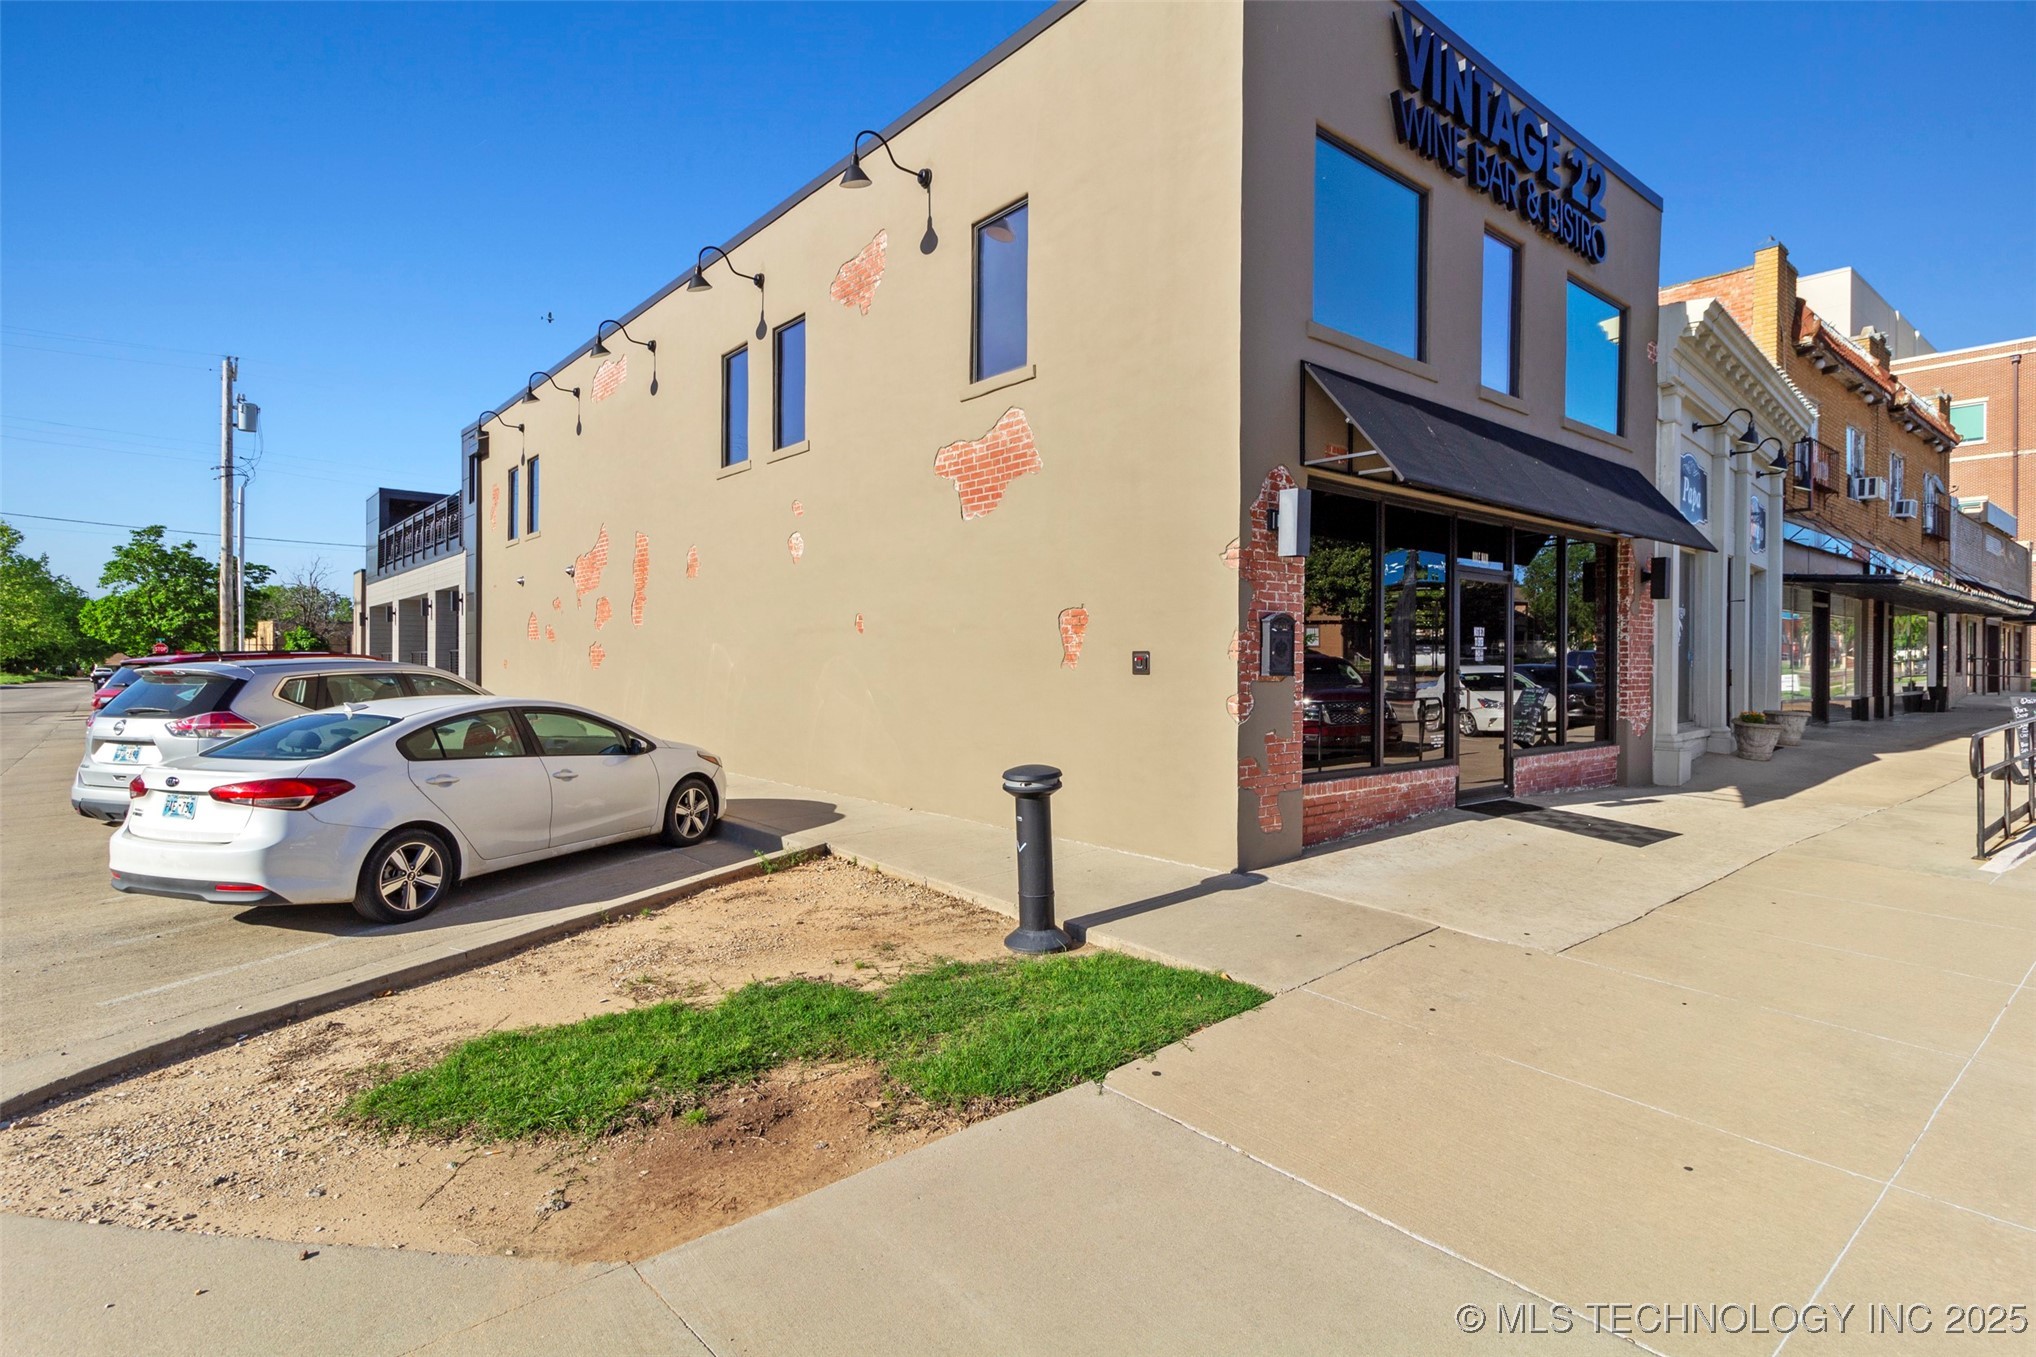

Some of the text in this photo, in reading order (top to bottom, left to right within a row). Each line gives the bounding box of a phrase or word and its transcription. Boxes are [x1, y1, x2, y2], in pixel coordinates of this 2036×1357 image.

[1394, 7, 1607, 222] VINTAGE 22
[1394, 91, 1607, 264] WINE BAR & BISTRO
[1682, 476, 1701, 512] Papa
